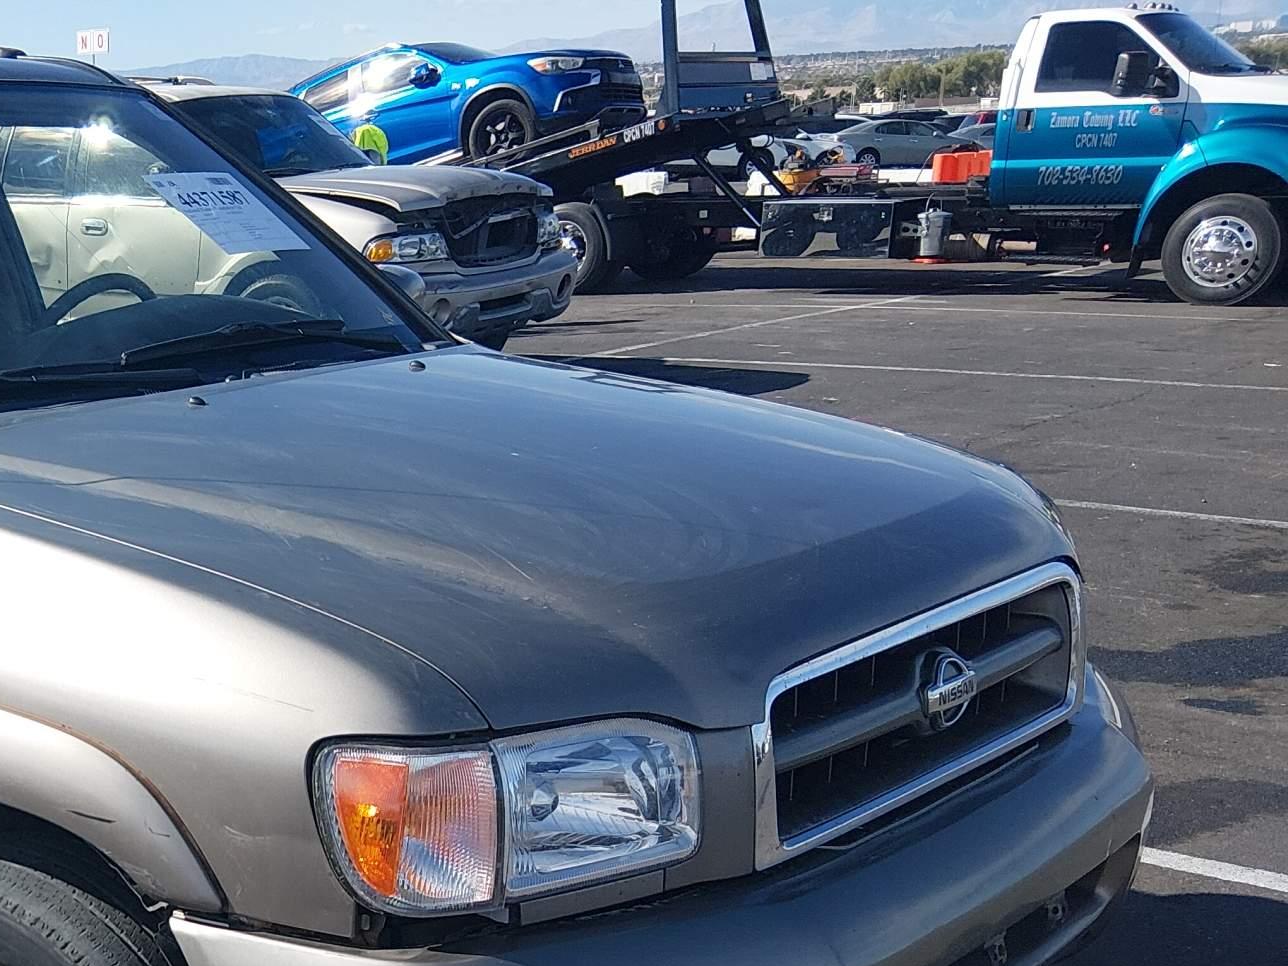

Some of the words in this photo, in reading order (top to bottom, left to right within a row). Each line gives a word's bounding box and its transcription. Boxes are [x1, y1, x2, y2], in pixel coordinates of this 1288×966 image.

[1075, 134, 1098, 148] CPCN
[1037, 165, 1124, 185] 702-534-8630
[177, 190, 250, 208] 44371587
[938, 678, 974, 706] NISSAN
